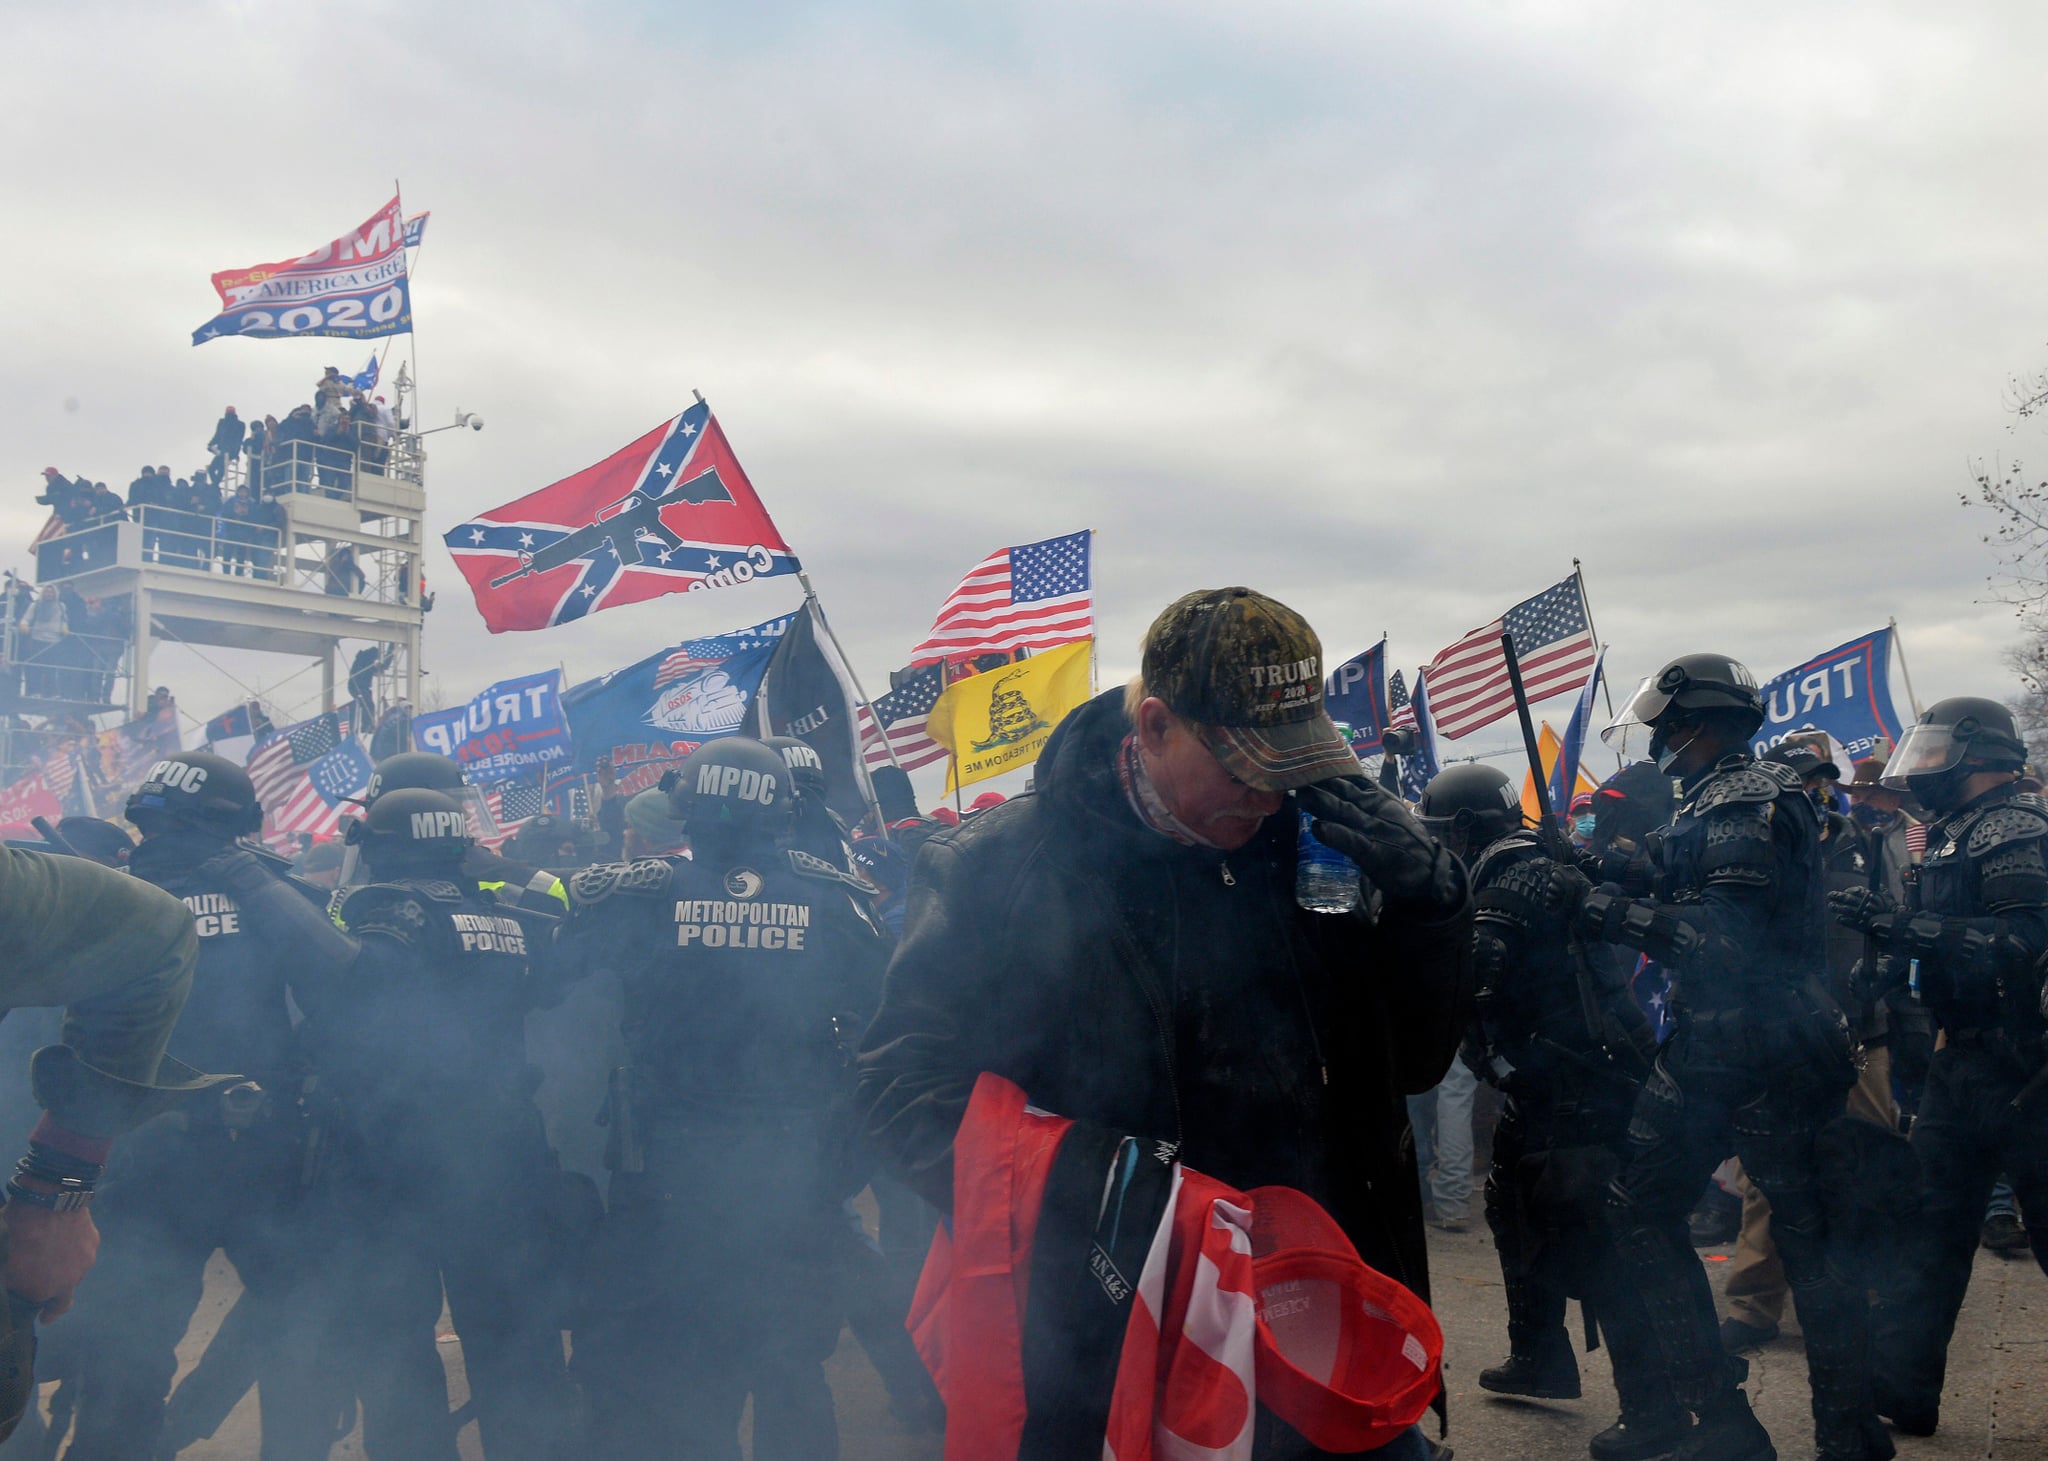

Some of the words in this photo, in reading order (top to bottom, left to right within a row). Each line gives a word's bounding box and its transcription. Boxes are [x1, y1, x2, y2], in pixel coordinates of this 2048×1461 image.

[258, 273, 359, 298] AMERICA
[240, 286, 402, 333] 2020
[1250, 656, 1317, 688] TRUMP
[1352, 726, 1374, 739] AT!
[144, 760, 208, 794] PDC
[696, 764, 776, 806] MPDC
[674, 900, 809, 928] METROPOLITAN
[460, 932, 527, 955] POLICE
[677, 924, 804, 951] POLICE
